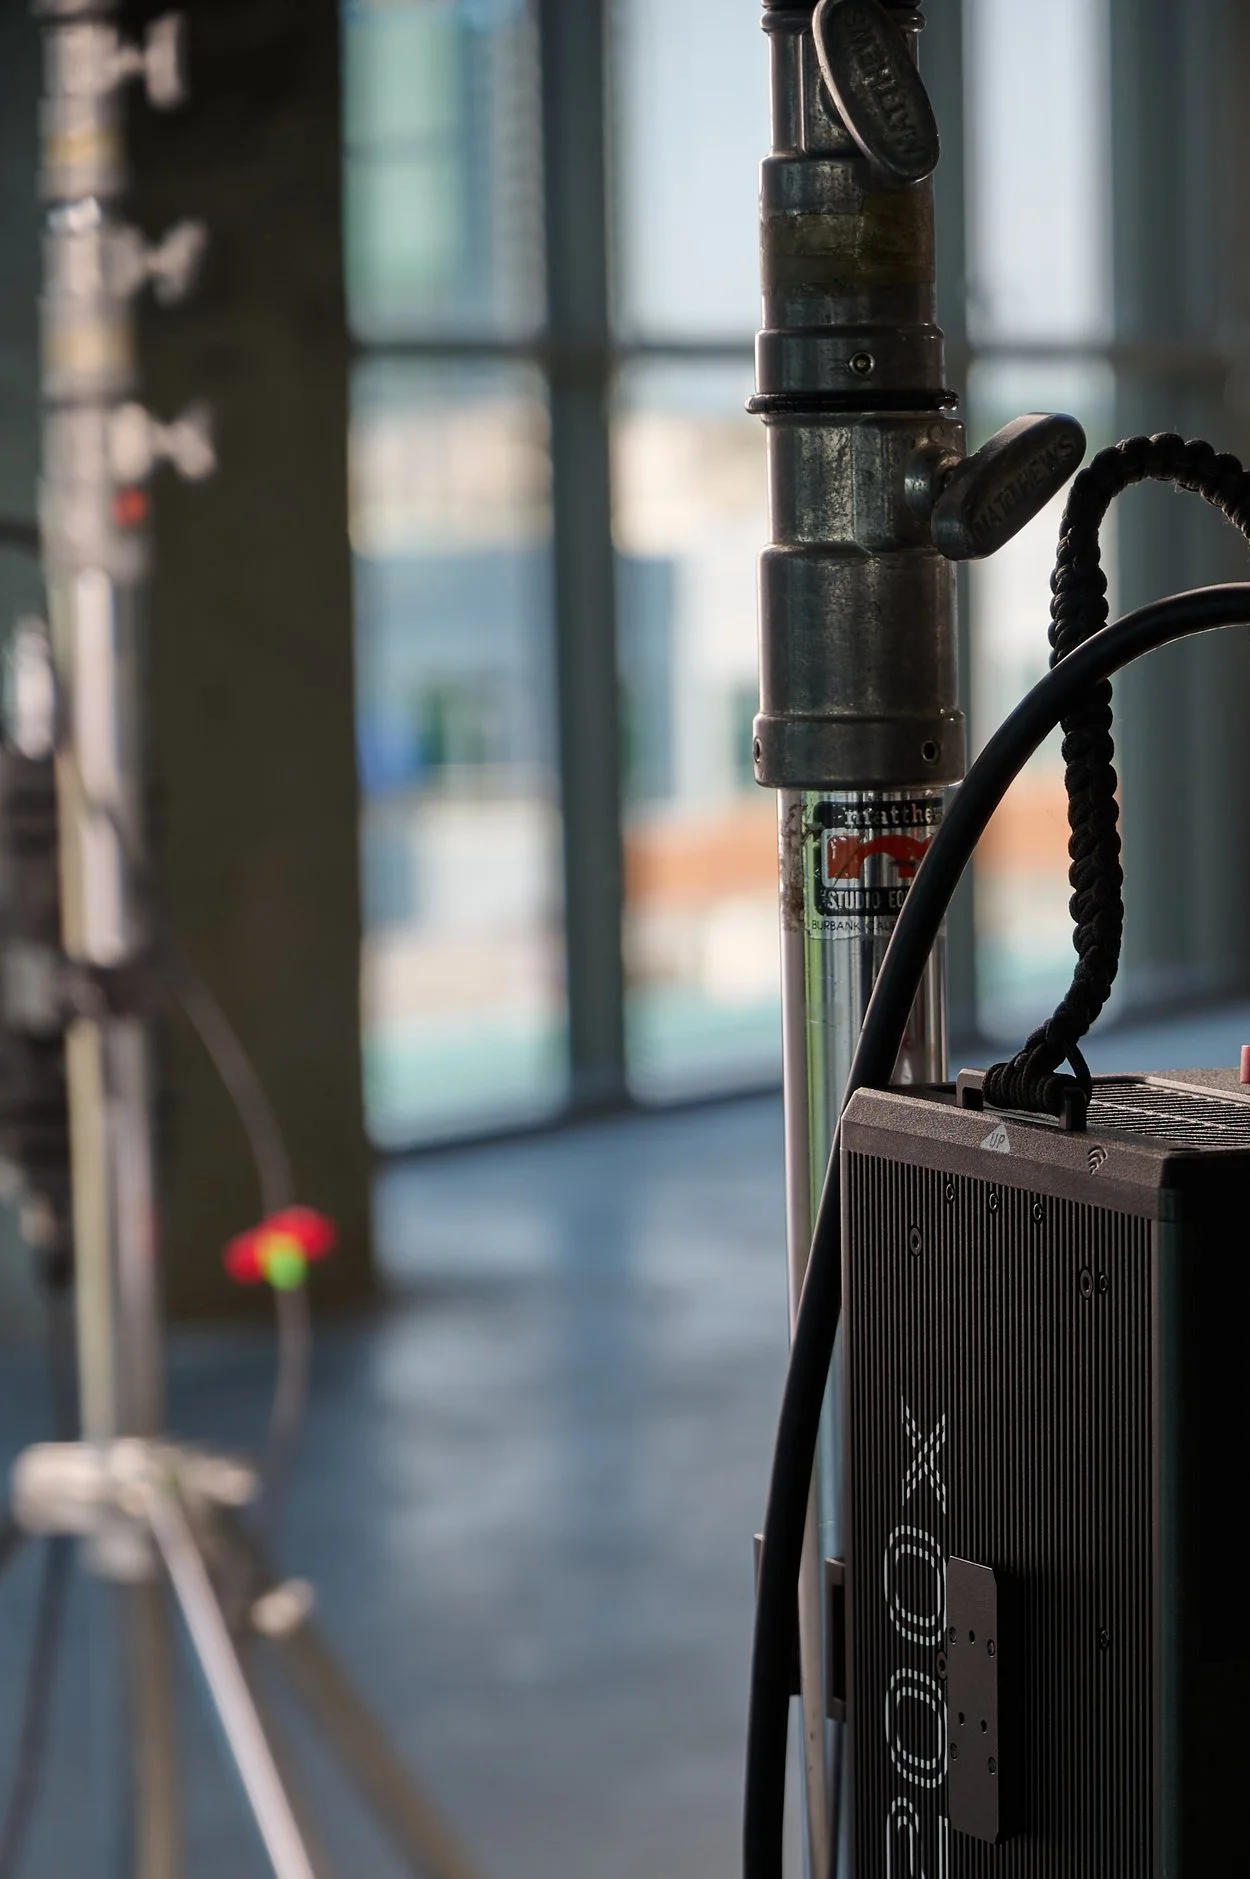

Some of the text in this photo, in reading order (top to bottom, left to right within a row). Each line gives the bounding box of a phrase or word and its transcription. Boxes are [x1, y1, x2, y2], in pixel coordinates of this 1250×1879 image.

[970, 433, 1077, 544] MATTHEWS
[844, 801, 943, 826] matthe
[827, 889, 881, 911] STUDIO
[811, 920, 861, 932] BURBANK
[990, 1132, 1006, 1149] UP
